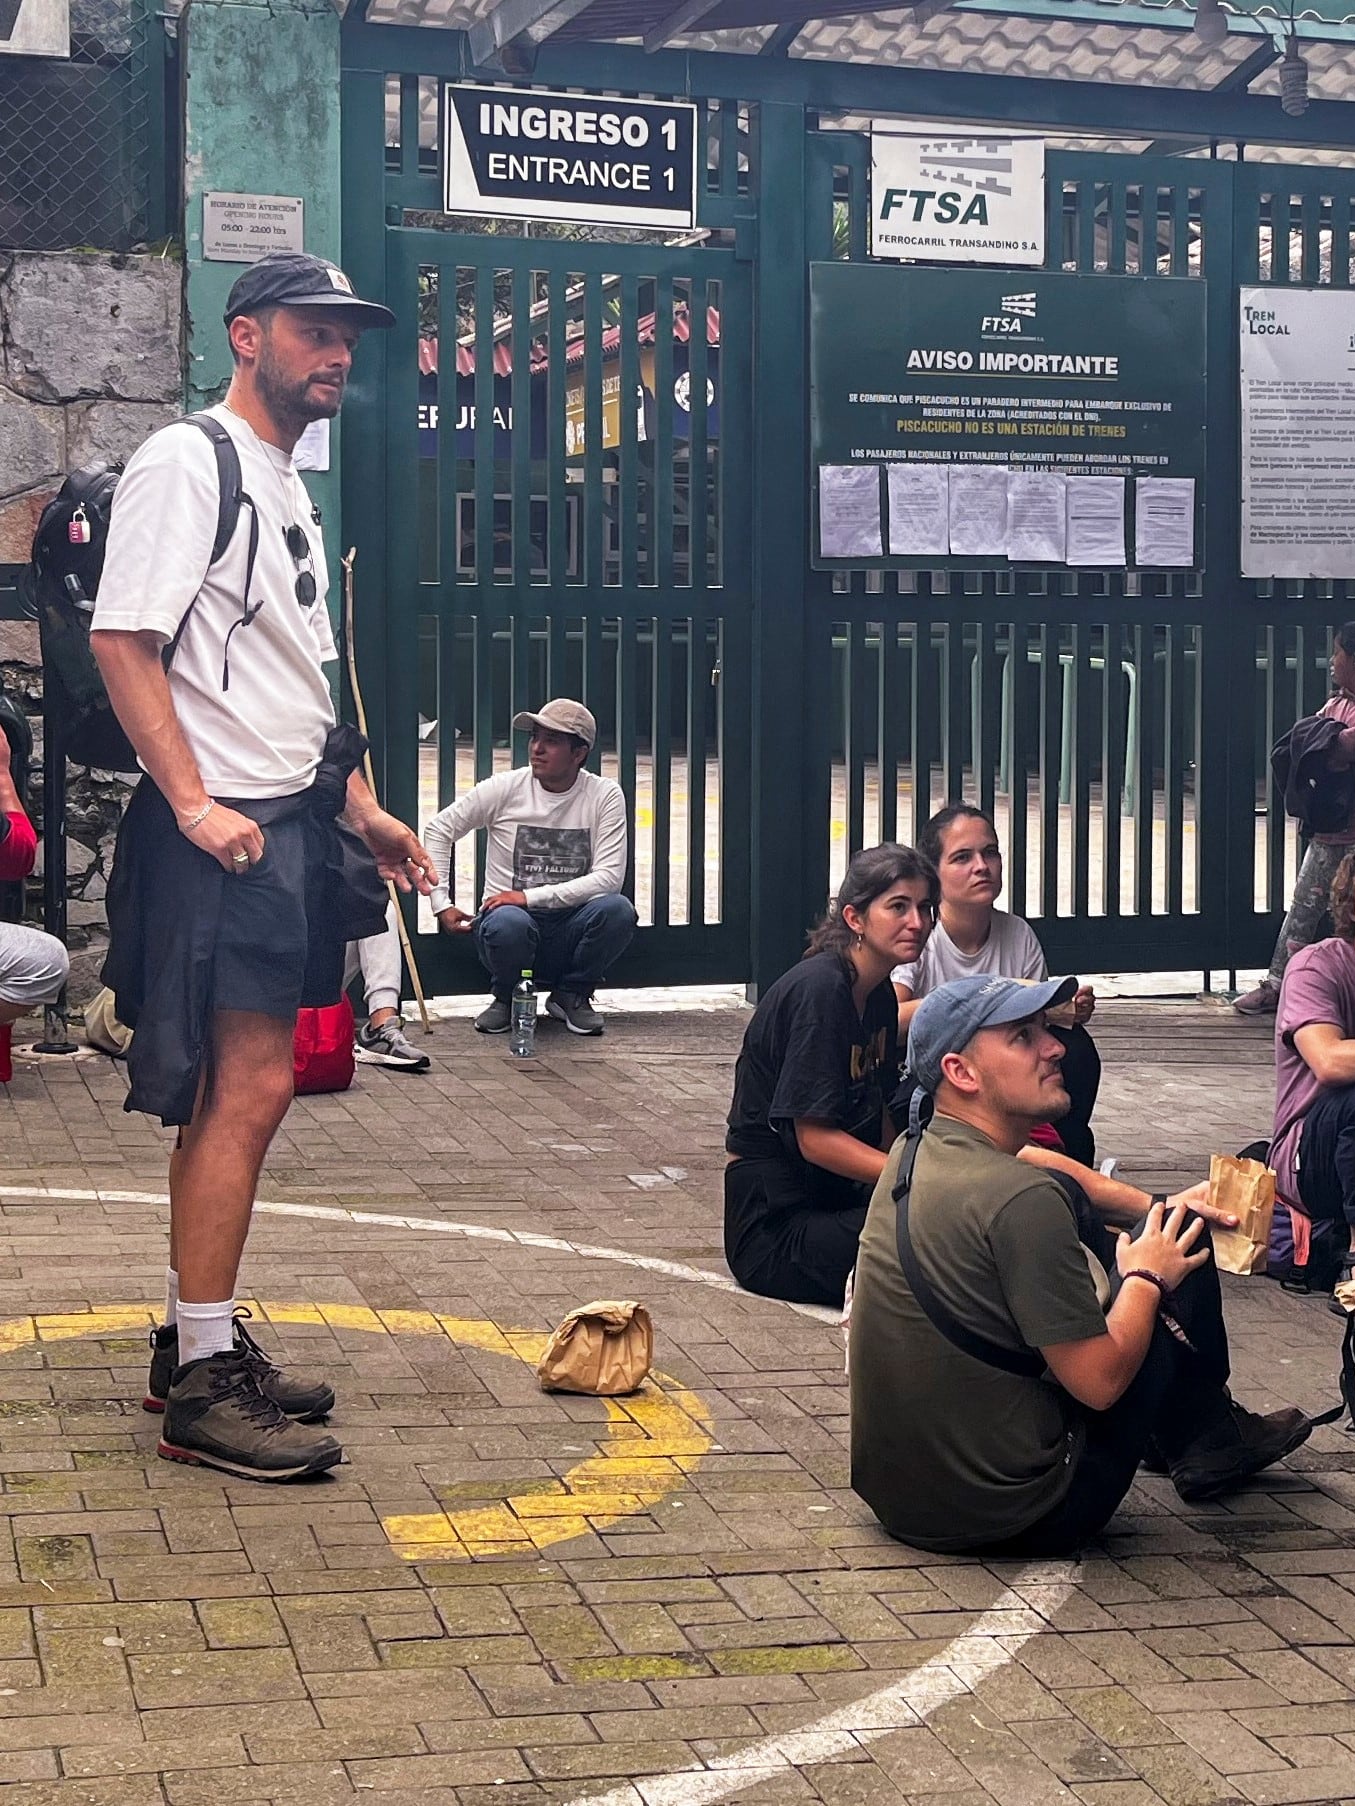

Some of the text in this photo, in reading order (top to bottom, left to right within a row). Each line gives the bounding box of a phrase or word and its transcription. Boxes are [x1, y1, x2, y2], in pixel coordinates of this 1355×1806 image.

[479, 103, 677, 151] INGRESO 1
[488, 152, 675, 192] ENTRANCE 1
[210, 200, 297, 213] HORARIO DE ATENCIÓN
[879, 188, 989, 226] FTSA
[221, 223, 243, 232] 05:00
[249, 225, 271, 234] 22:00
[878, 234, 1040, 251] FERROCARRIL TRANSANDINO S.A.
[981, 317, 1022, 333] FTSA
[906, 350, 1119, 375] AVISO IMPORTANTE
[849, 393, 1172, 412] SE COMUNICA QUE PISCACUCHO ES UN PARADERO INTERMEDIO PARA EMBARQUE EXCLUSIVO DE
[922, 407, 965, 418] RESIDENTES
[966, 408, 976, 418] DE
[977, 409, 986, 418] LA
[987, 409, 1005, 419] ZONA
[1058, 411, 1073, 421] CON
[1074, 411, 1083, 421] EL
[897, 420, 1126, 437] PISCACUCHO NO ES UNA ESTACIÓN DE TRENES
[850, 449, 865, 458] LOS
[866, 449, 907, 459] PASAJEROS
[908, 450, 951, 460] NACIONALES
[952, 451, 958, 460] Y
[959, 451, 1008, 461] EXTRANJEROS
[1056, 452, 1083, 463] PUEDEN
[1085, 453, 1117, 463] ABORDAR
[1118, 454, 1131, 464] LOS
[1133, 454, 1158, 465] TRENES
[1159, 455, 1169, 465] EN
